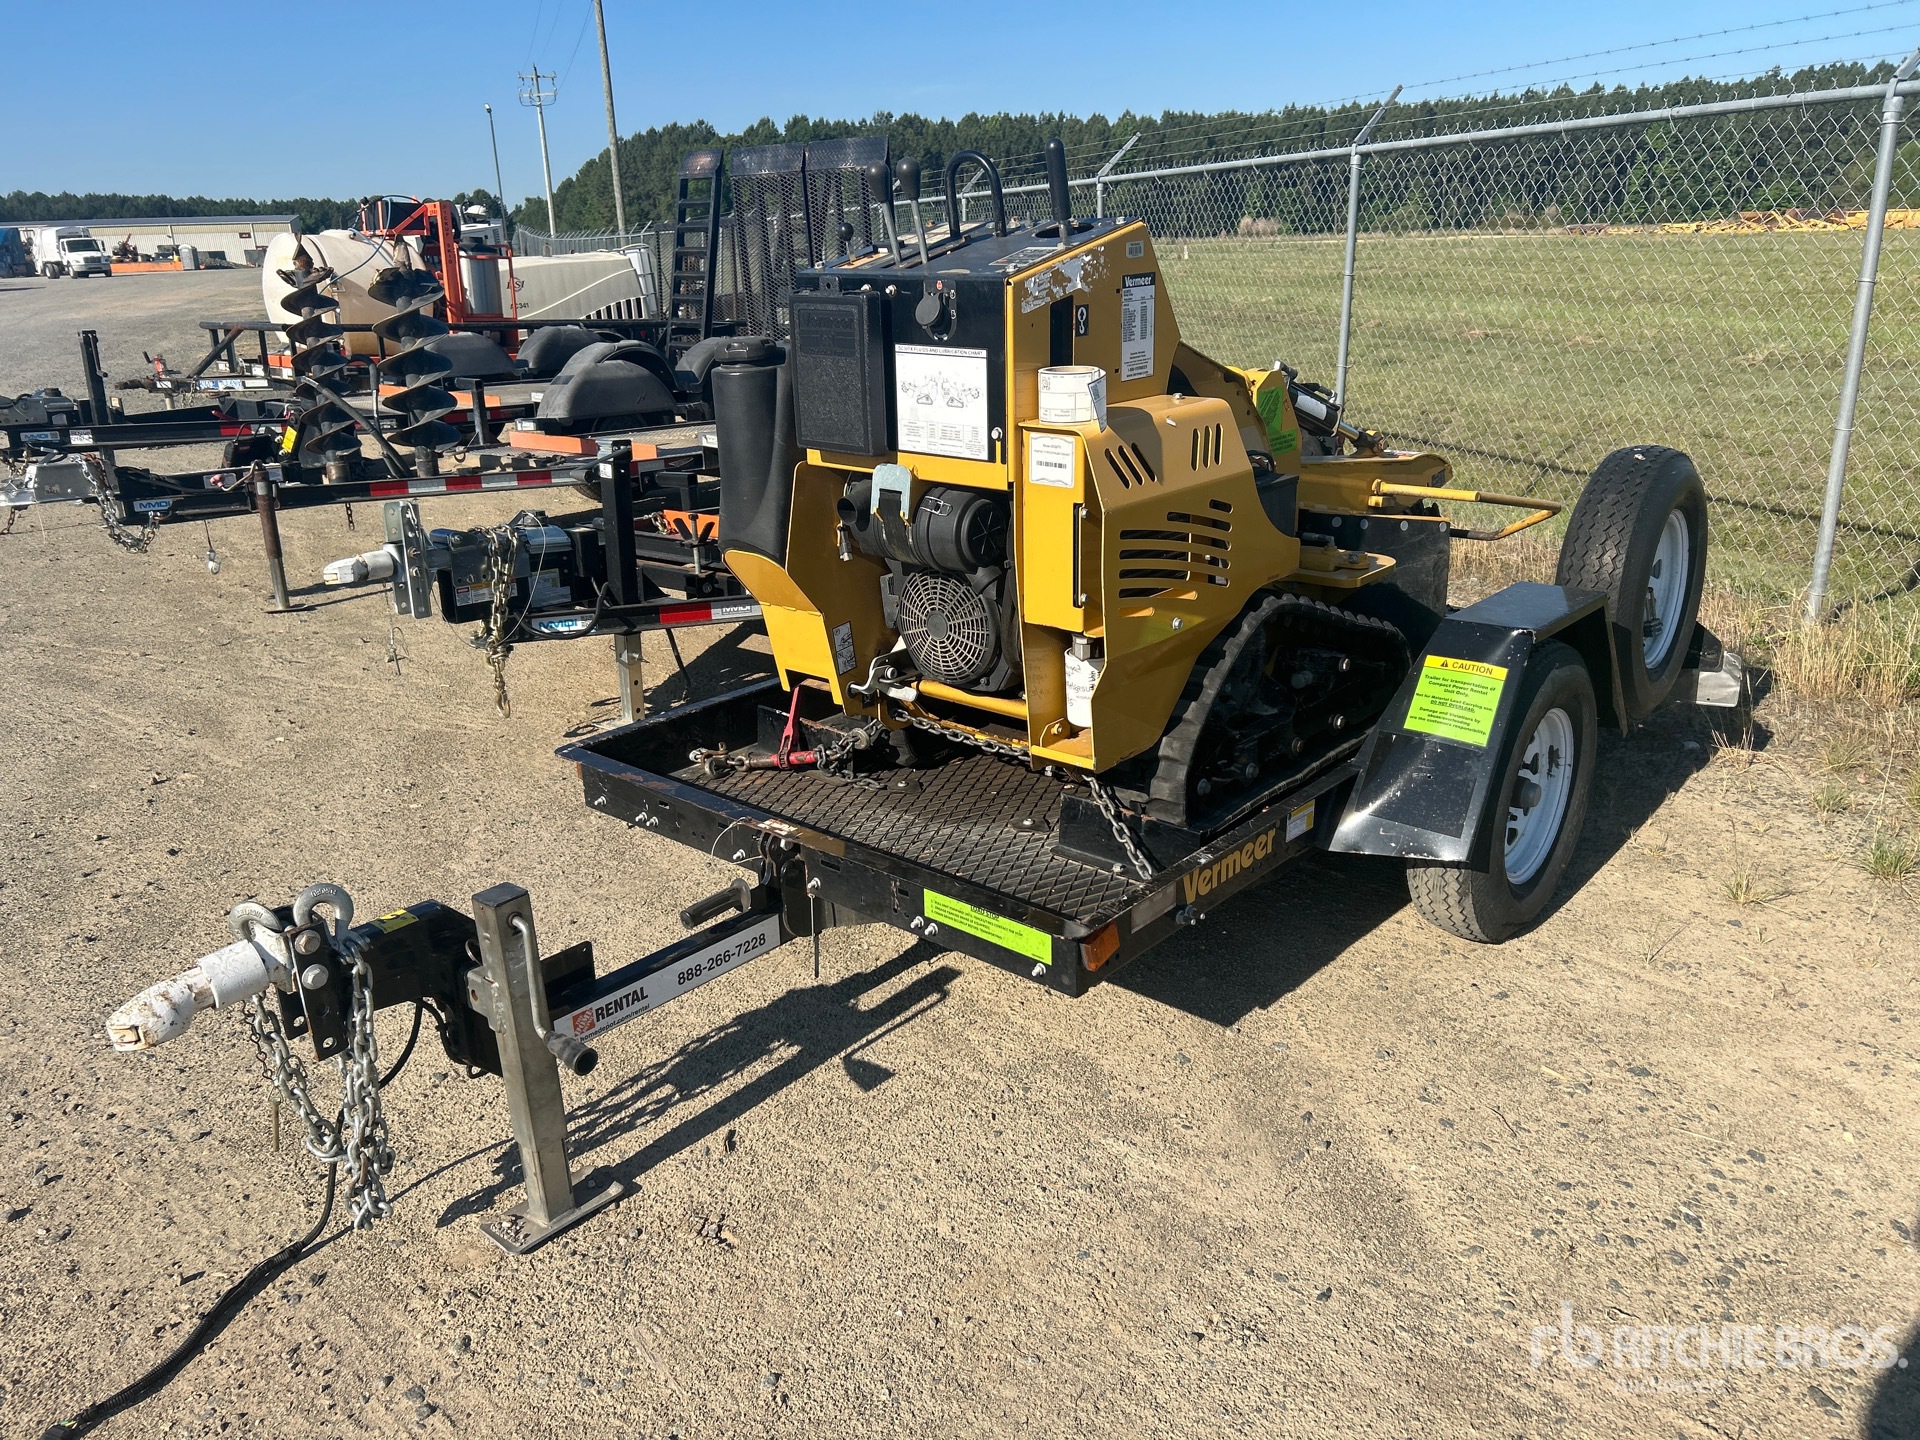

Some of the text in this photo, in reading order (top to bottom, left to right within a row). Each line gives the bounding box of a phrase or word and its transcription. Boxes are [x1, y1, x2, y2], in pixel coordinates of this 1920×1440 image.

[1124, 275, 1152, 287] Vermeer
[139, 501, 171, 509] MMDI
[1452, 661, 1493, 675] CAUTION
[1450, 679, 1488, 690] transportation
[1183, 828, 1276, 905] Vermeer
[677, 933, 766, 986] 888-266-7228
[595, 986, 648, 1022] RENTAL
[580, 1003, 650, 1042] homedepot.com/rental
